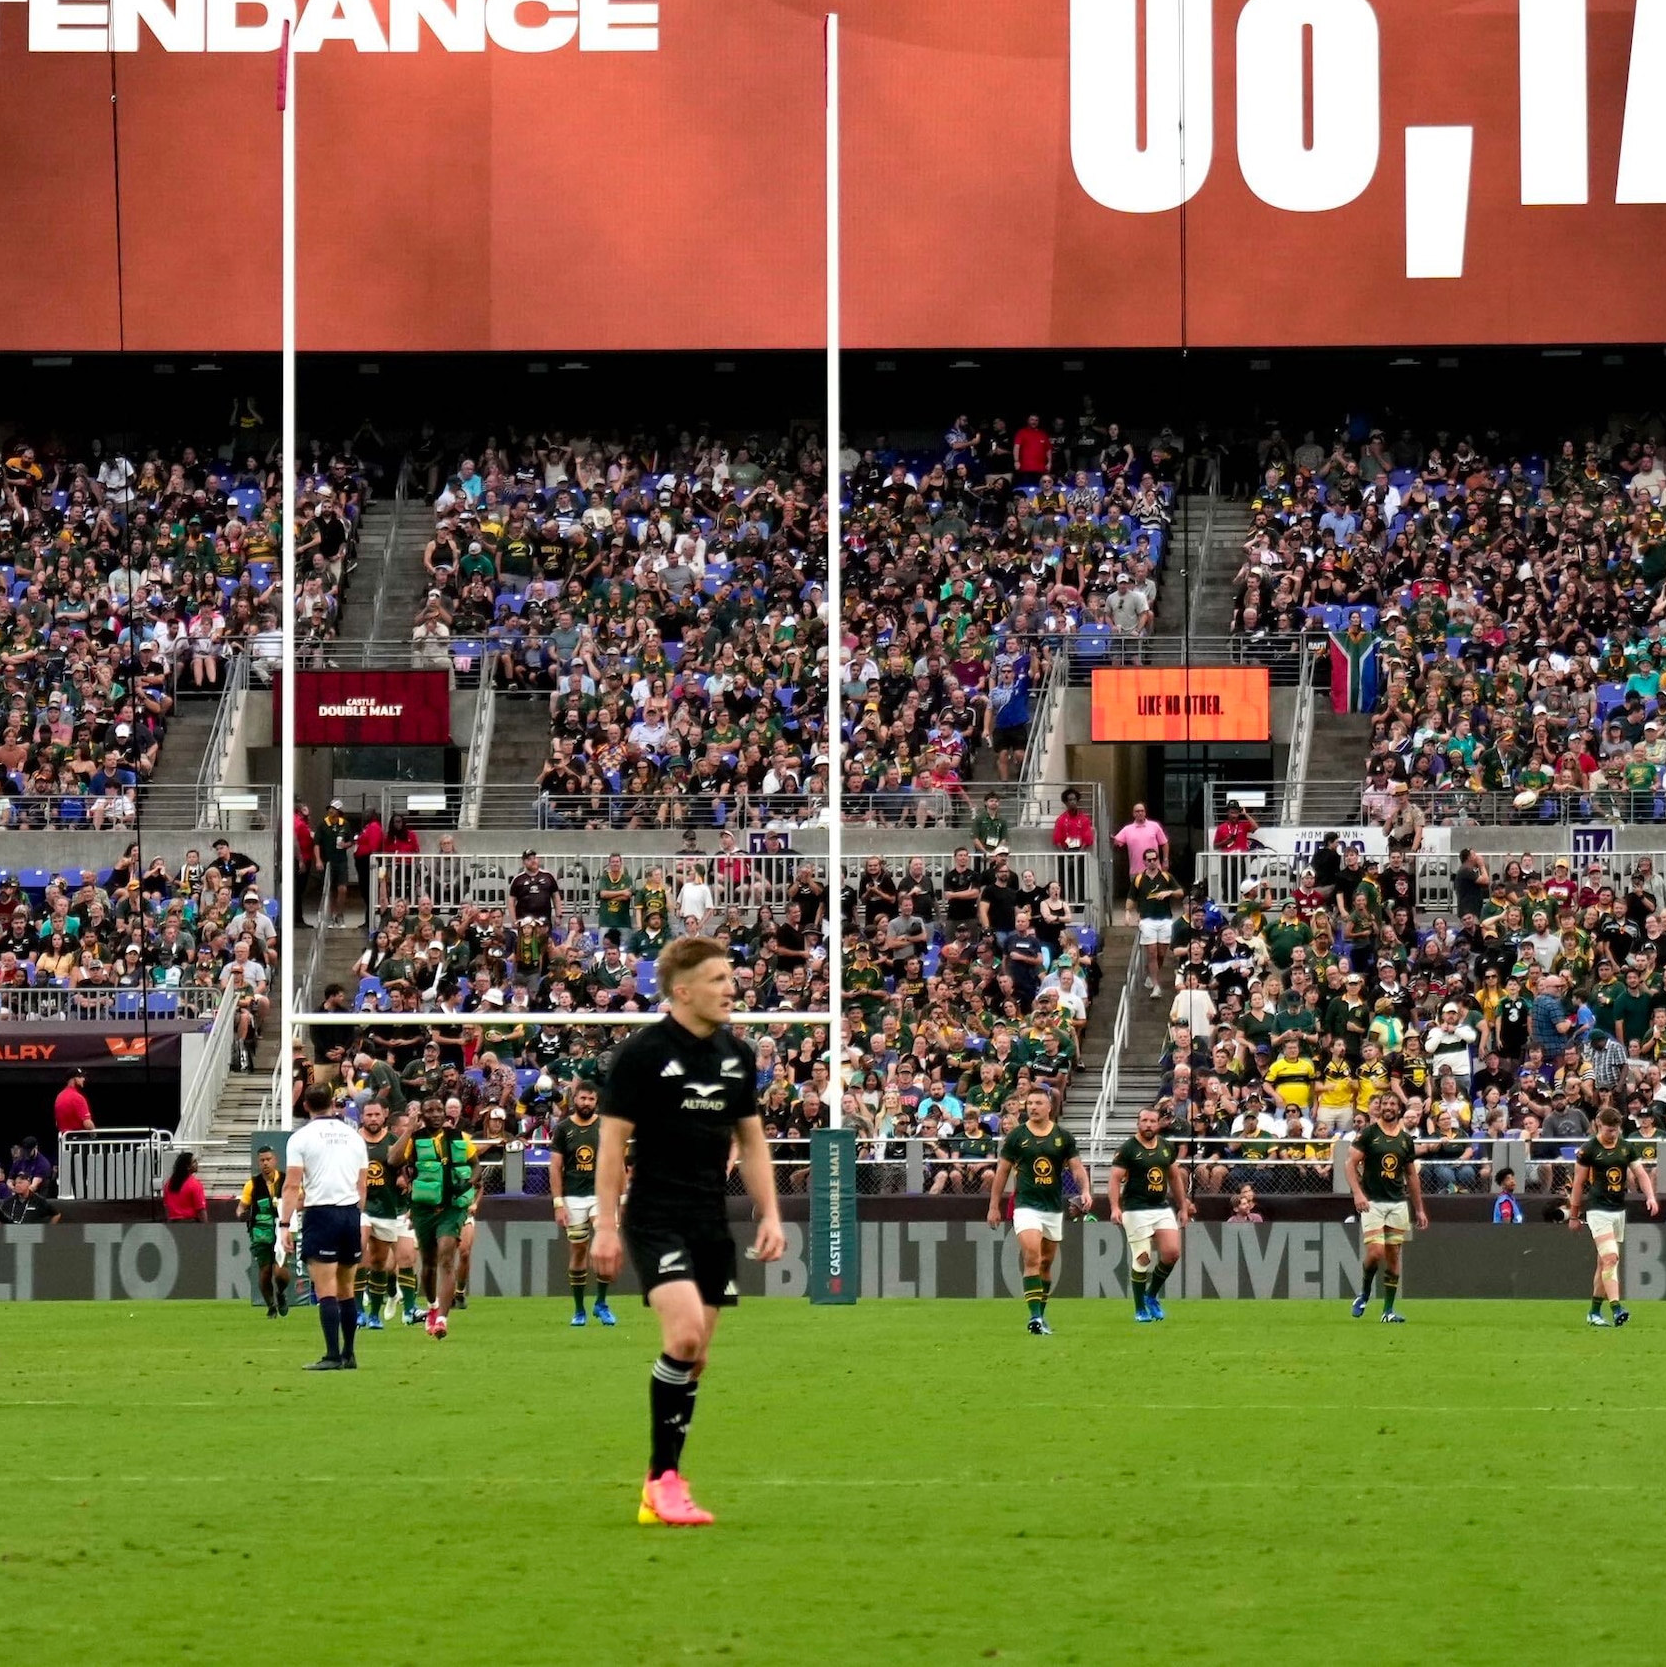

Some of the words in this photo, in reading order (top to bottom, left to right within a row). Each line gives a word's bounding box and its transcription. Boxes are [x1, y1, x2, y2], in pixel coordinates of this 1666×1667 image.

[346, 698, 375, 706] CASTLE
[1138, 696, 1162, 716] LIKE
[1165, 696, 1181, 715] NO
[1184, 695, 1224, 715] OTHER.
[319, 706, 366, 716] DOUBLE
[370, 706, 403, 716] MALT
[1508, 1008, 1519, 1022] 3
[680, 1098, 729, 1112] ALTRAD
[830, 1142, 841, 1174] MALT
[1035, 1177, 1052, 1185] FNB
[1148, 1184, 1164, 1192] FNB
[830, 1176, 841, 1227] DOUBLE
[765, 1221, 950, 1299] BILT
[830, 1229, 841, 1276] CASTLE
[86, 1225, 179, 1301] TO
